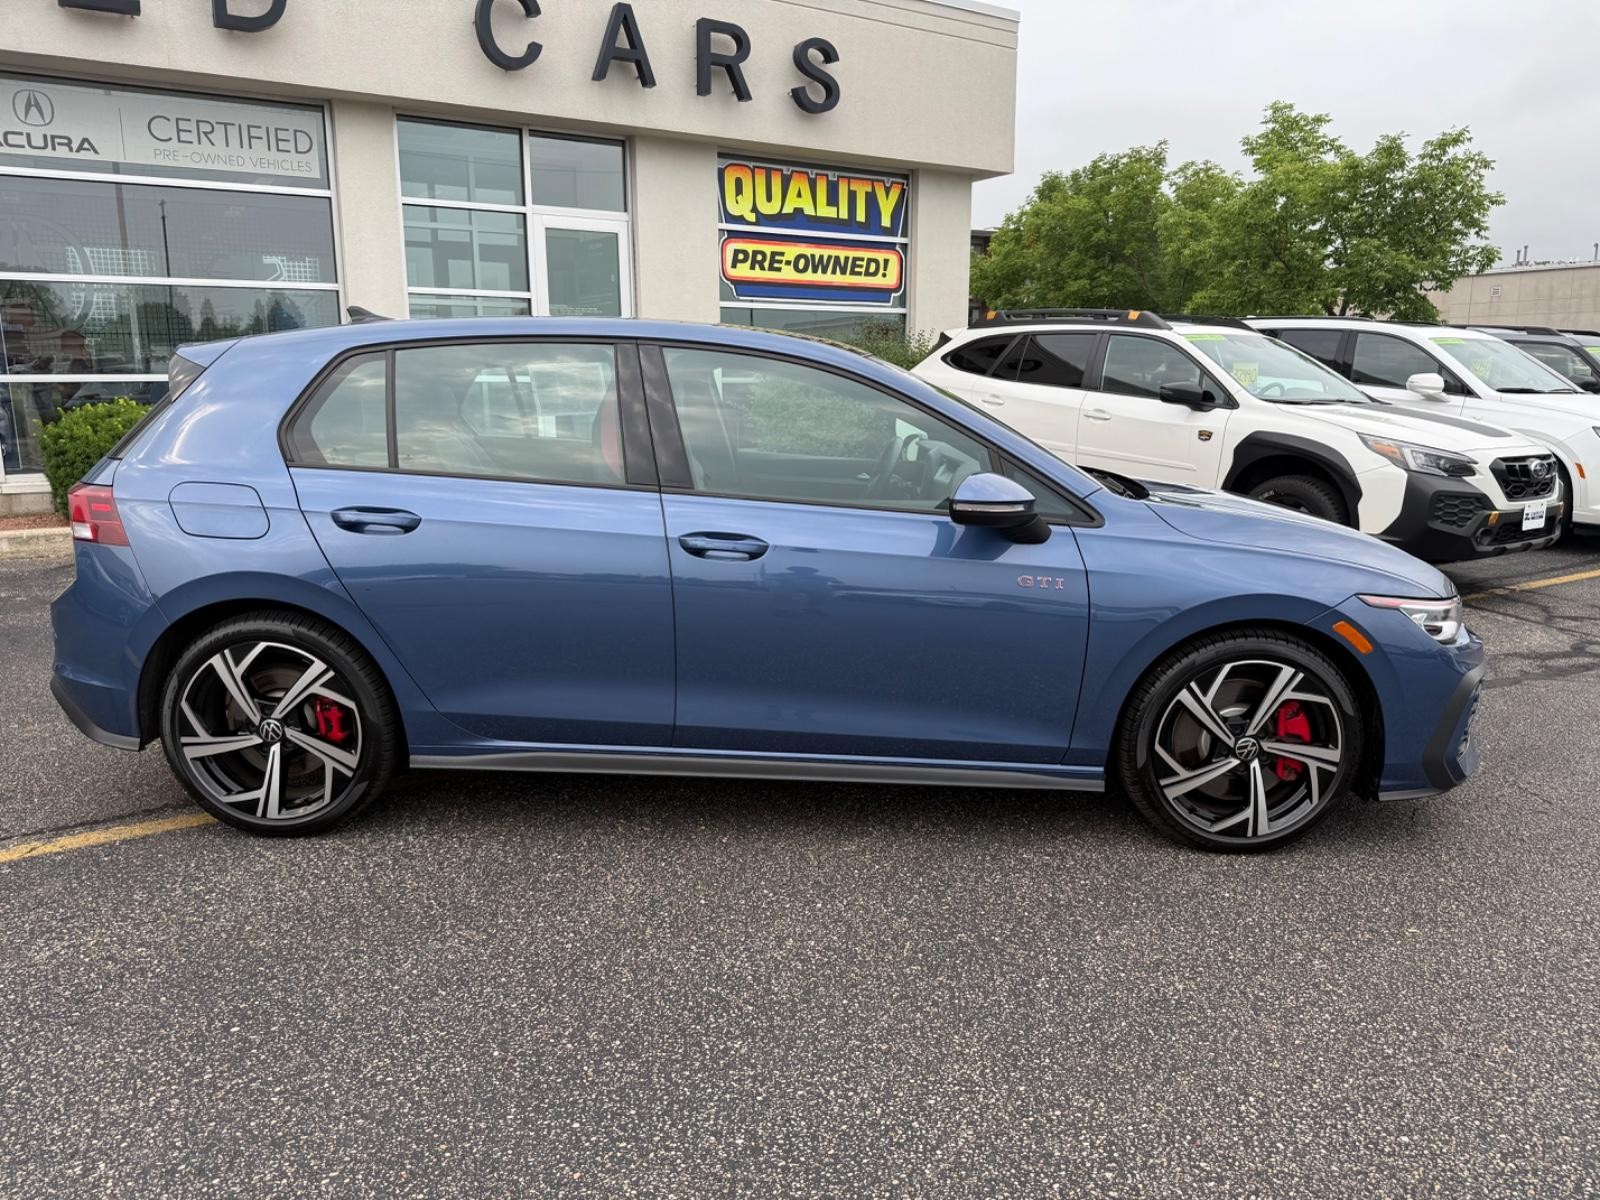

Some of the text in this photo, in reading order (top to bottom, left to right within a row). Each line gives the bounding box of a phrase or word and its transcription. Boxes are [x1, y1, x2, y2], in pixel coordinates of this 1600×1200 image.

[474, 0, 841, 114] CARS
[0, 130, 101, 156] CURA
[147, 114, 314, 155] CERTIFIED
[153, 148, 313, 173] PRE-OWNED VEHICLES
[724, 162, 904, 229] QUALITY
[730, 248, 890, 278] PRE-OWNED!
[1016, 574, 1065, 590] GTI
